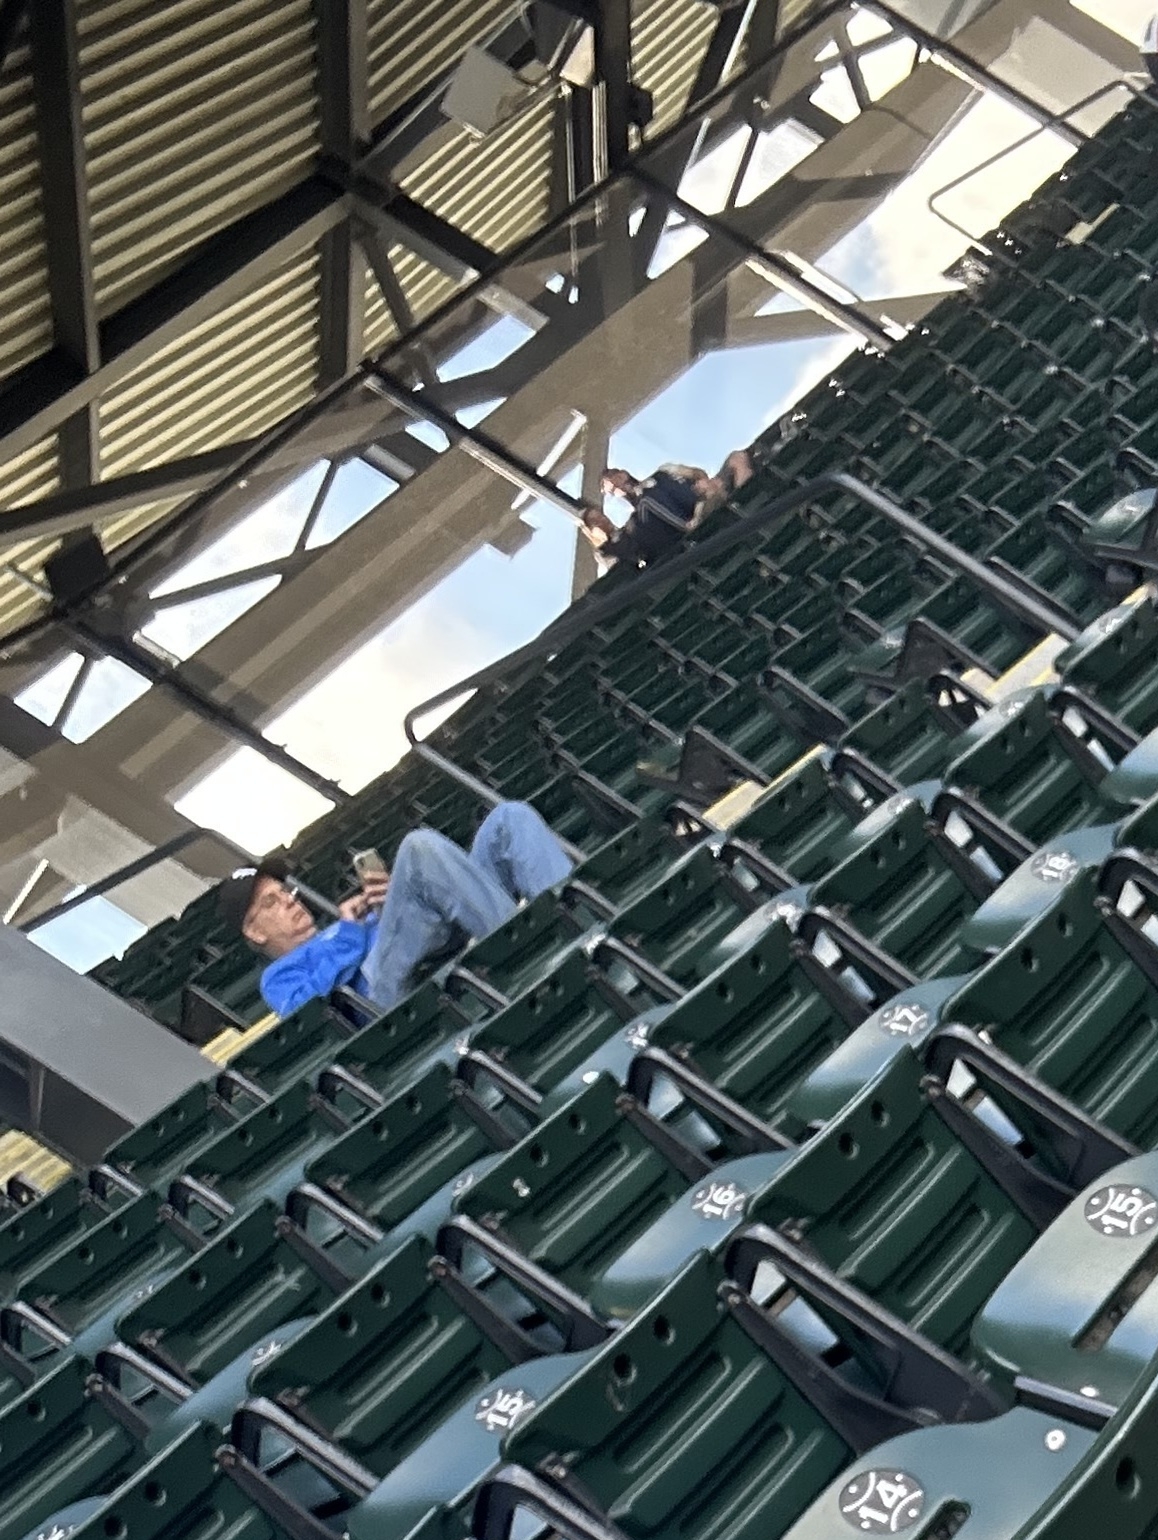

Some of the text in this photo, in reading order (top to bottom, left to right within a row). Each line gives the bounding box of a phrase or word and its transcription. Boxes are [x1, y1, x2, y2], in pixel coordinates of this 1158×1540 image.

[1041, 857, 1069, 878] 18
[889, 1006, 918, 1032] 17
[702, 1186, 736, 1215] 16
[1101, 1191, 1143, 1228] 15
[487, 1392, 523, 1427] 15
[858, 1478, 908, 1525] 14
